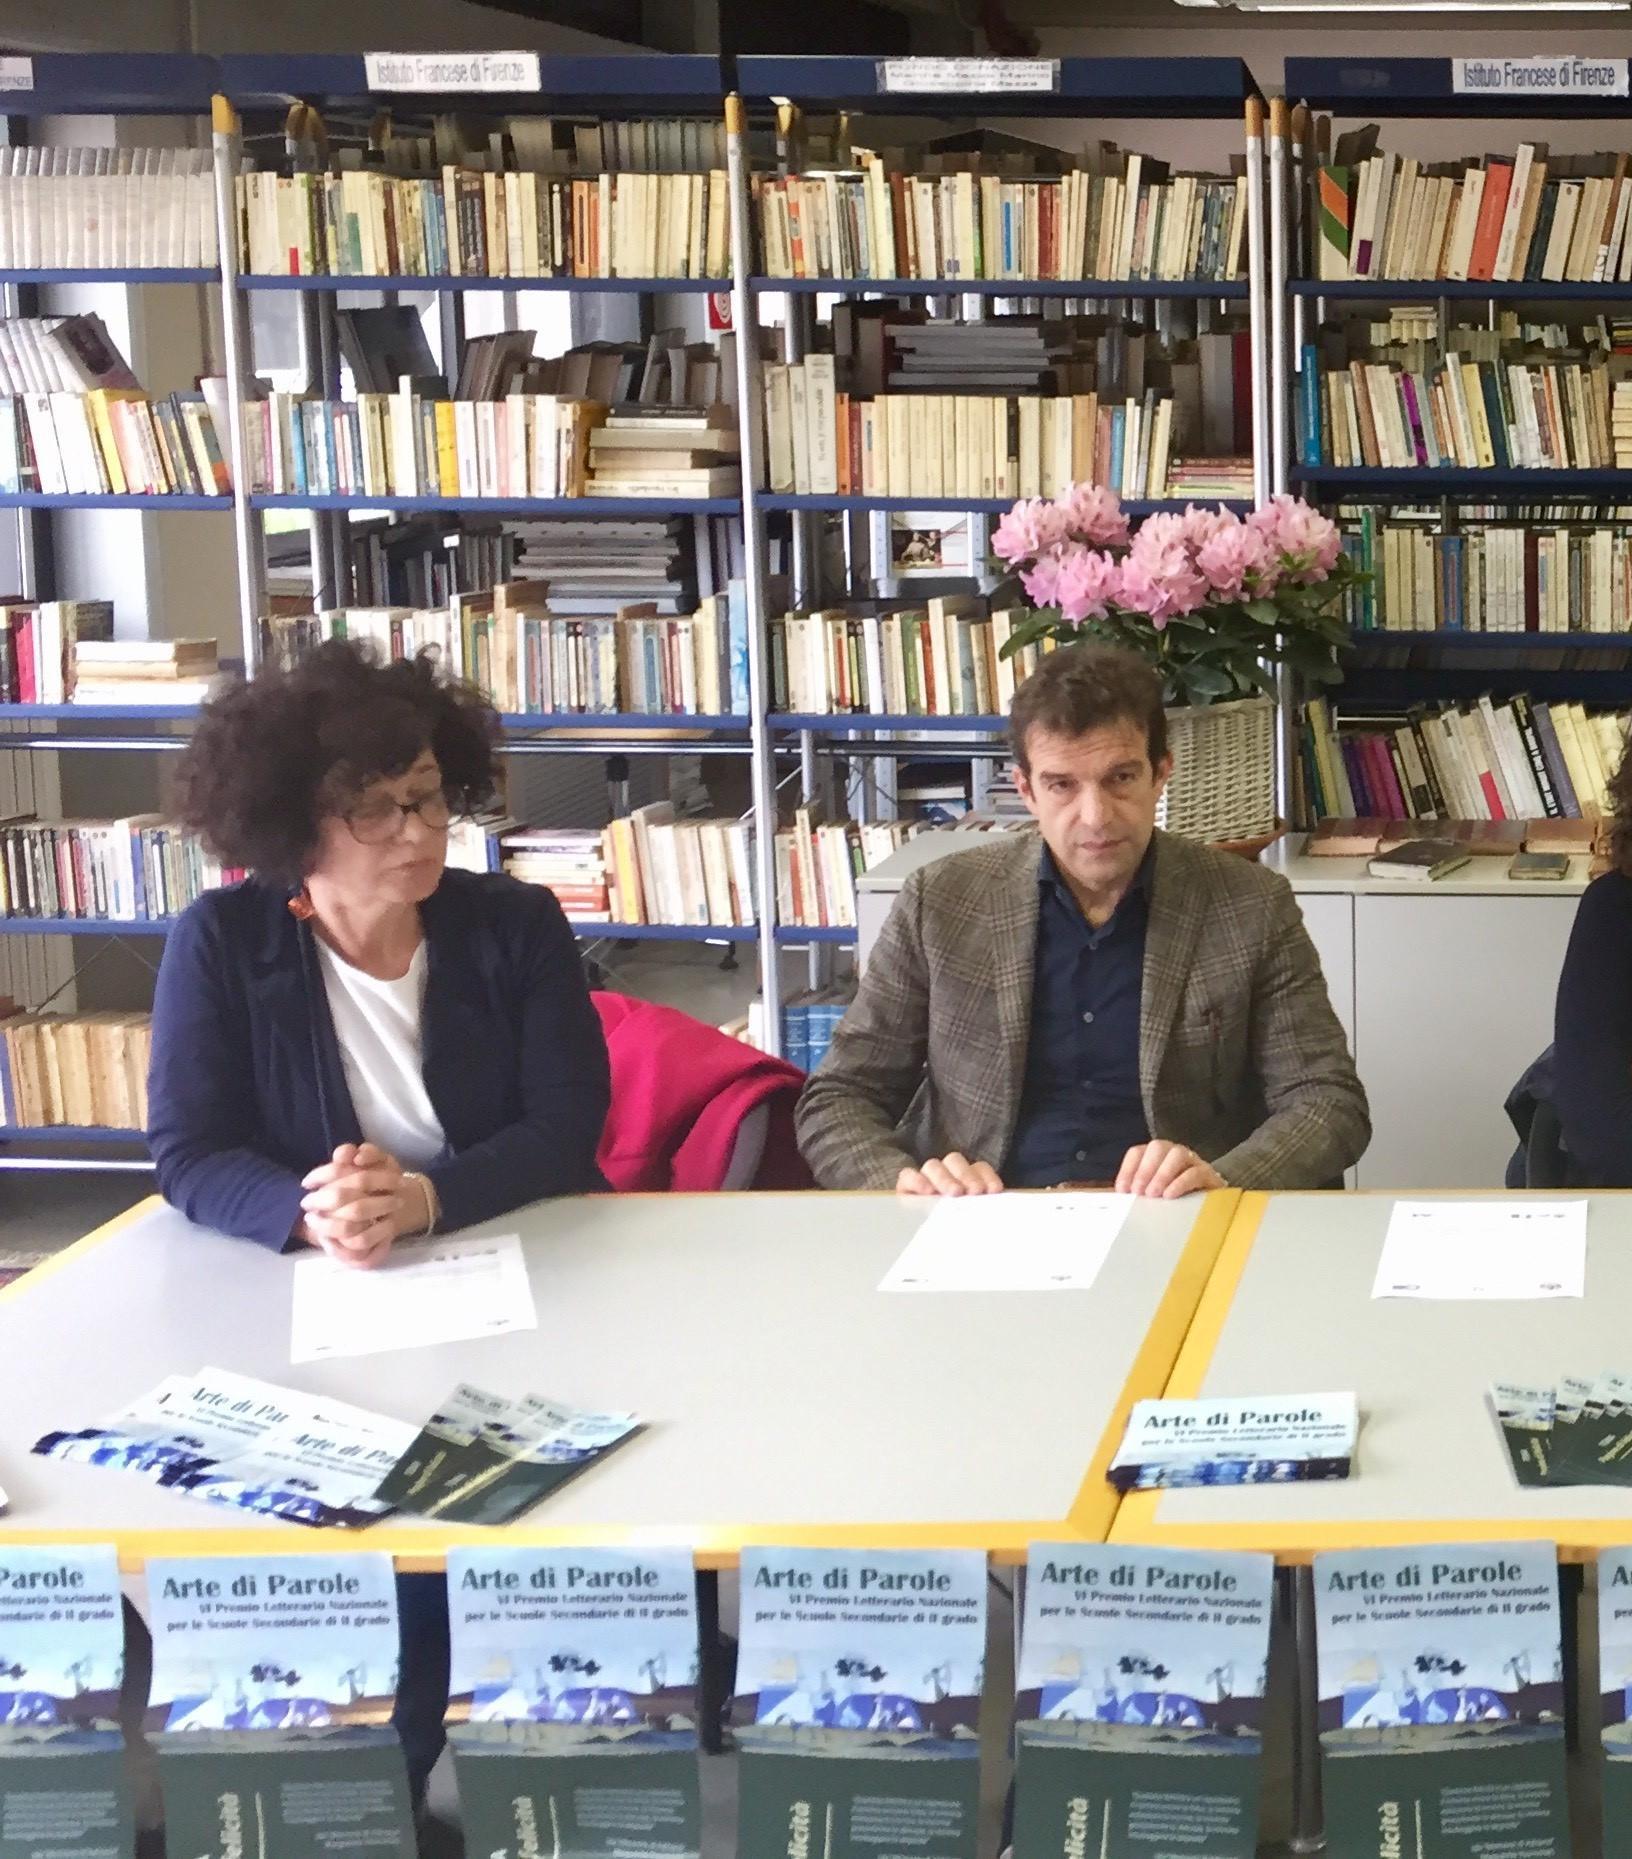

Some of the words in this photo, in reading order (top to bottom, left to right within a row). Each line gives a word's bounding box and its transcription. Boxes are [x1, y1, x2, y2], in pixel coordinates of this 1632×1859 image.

[377, 59, 414, 83] Istituto
[416, 58, 467, 83] Francese
[470, 58, 480, 81] di
[482, 58, 524, 81] Firenze
[1464, 63, 1500, 87] Istituto
[1504, 62, 1556, 86] Francese
[1559, 63, 1569, 86] di
[1573, 61, 1615, 86] Firenze
[191, 1387, 229, 1408] Arte
[230, 1398, 254, 1414] di
[1145, 1415, 1196, 1428] Arte
[1207, 1412, 1228, 1426] di
[1240, 1409, 1322, 1425] Parole
[292, 1432, 337, 1454] Arte
[163, 1577, 221, 1600] Arte
[231, 1574, 257, 1597] di
[268, 1572, 360, 1595] Parole
[462, 1567, 520, 1590] Arte
[530, 1566, 555, 1589] di
[567, 1565, 659, 1588] Parole
[754, 1566, 812, 1590] Arte
[823, 1567, 848, 1590] di
[860, 1568, 951, 1592] Parole
[1041, 1561, 1099, 1586] Arte
[1110, 1564, 1135, 1587] di
[1146, 1565, 1238, 1592] Parole
[1328, 1569, 1386, 1592] Arte
[1396, 1564, 1421, 1587] di
[1432, 1560, 1522, 1585] Parole
